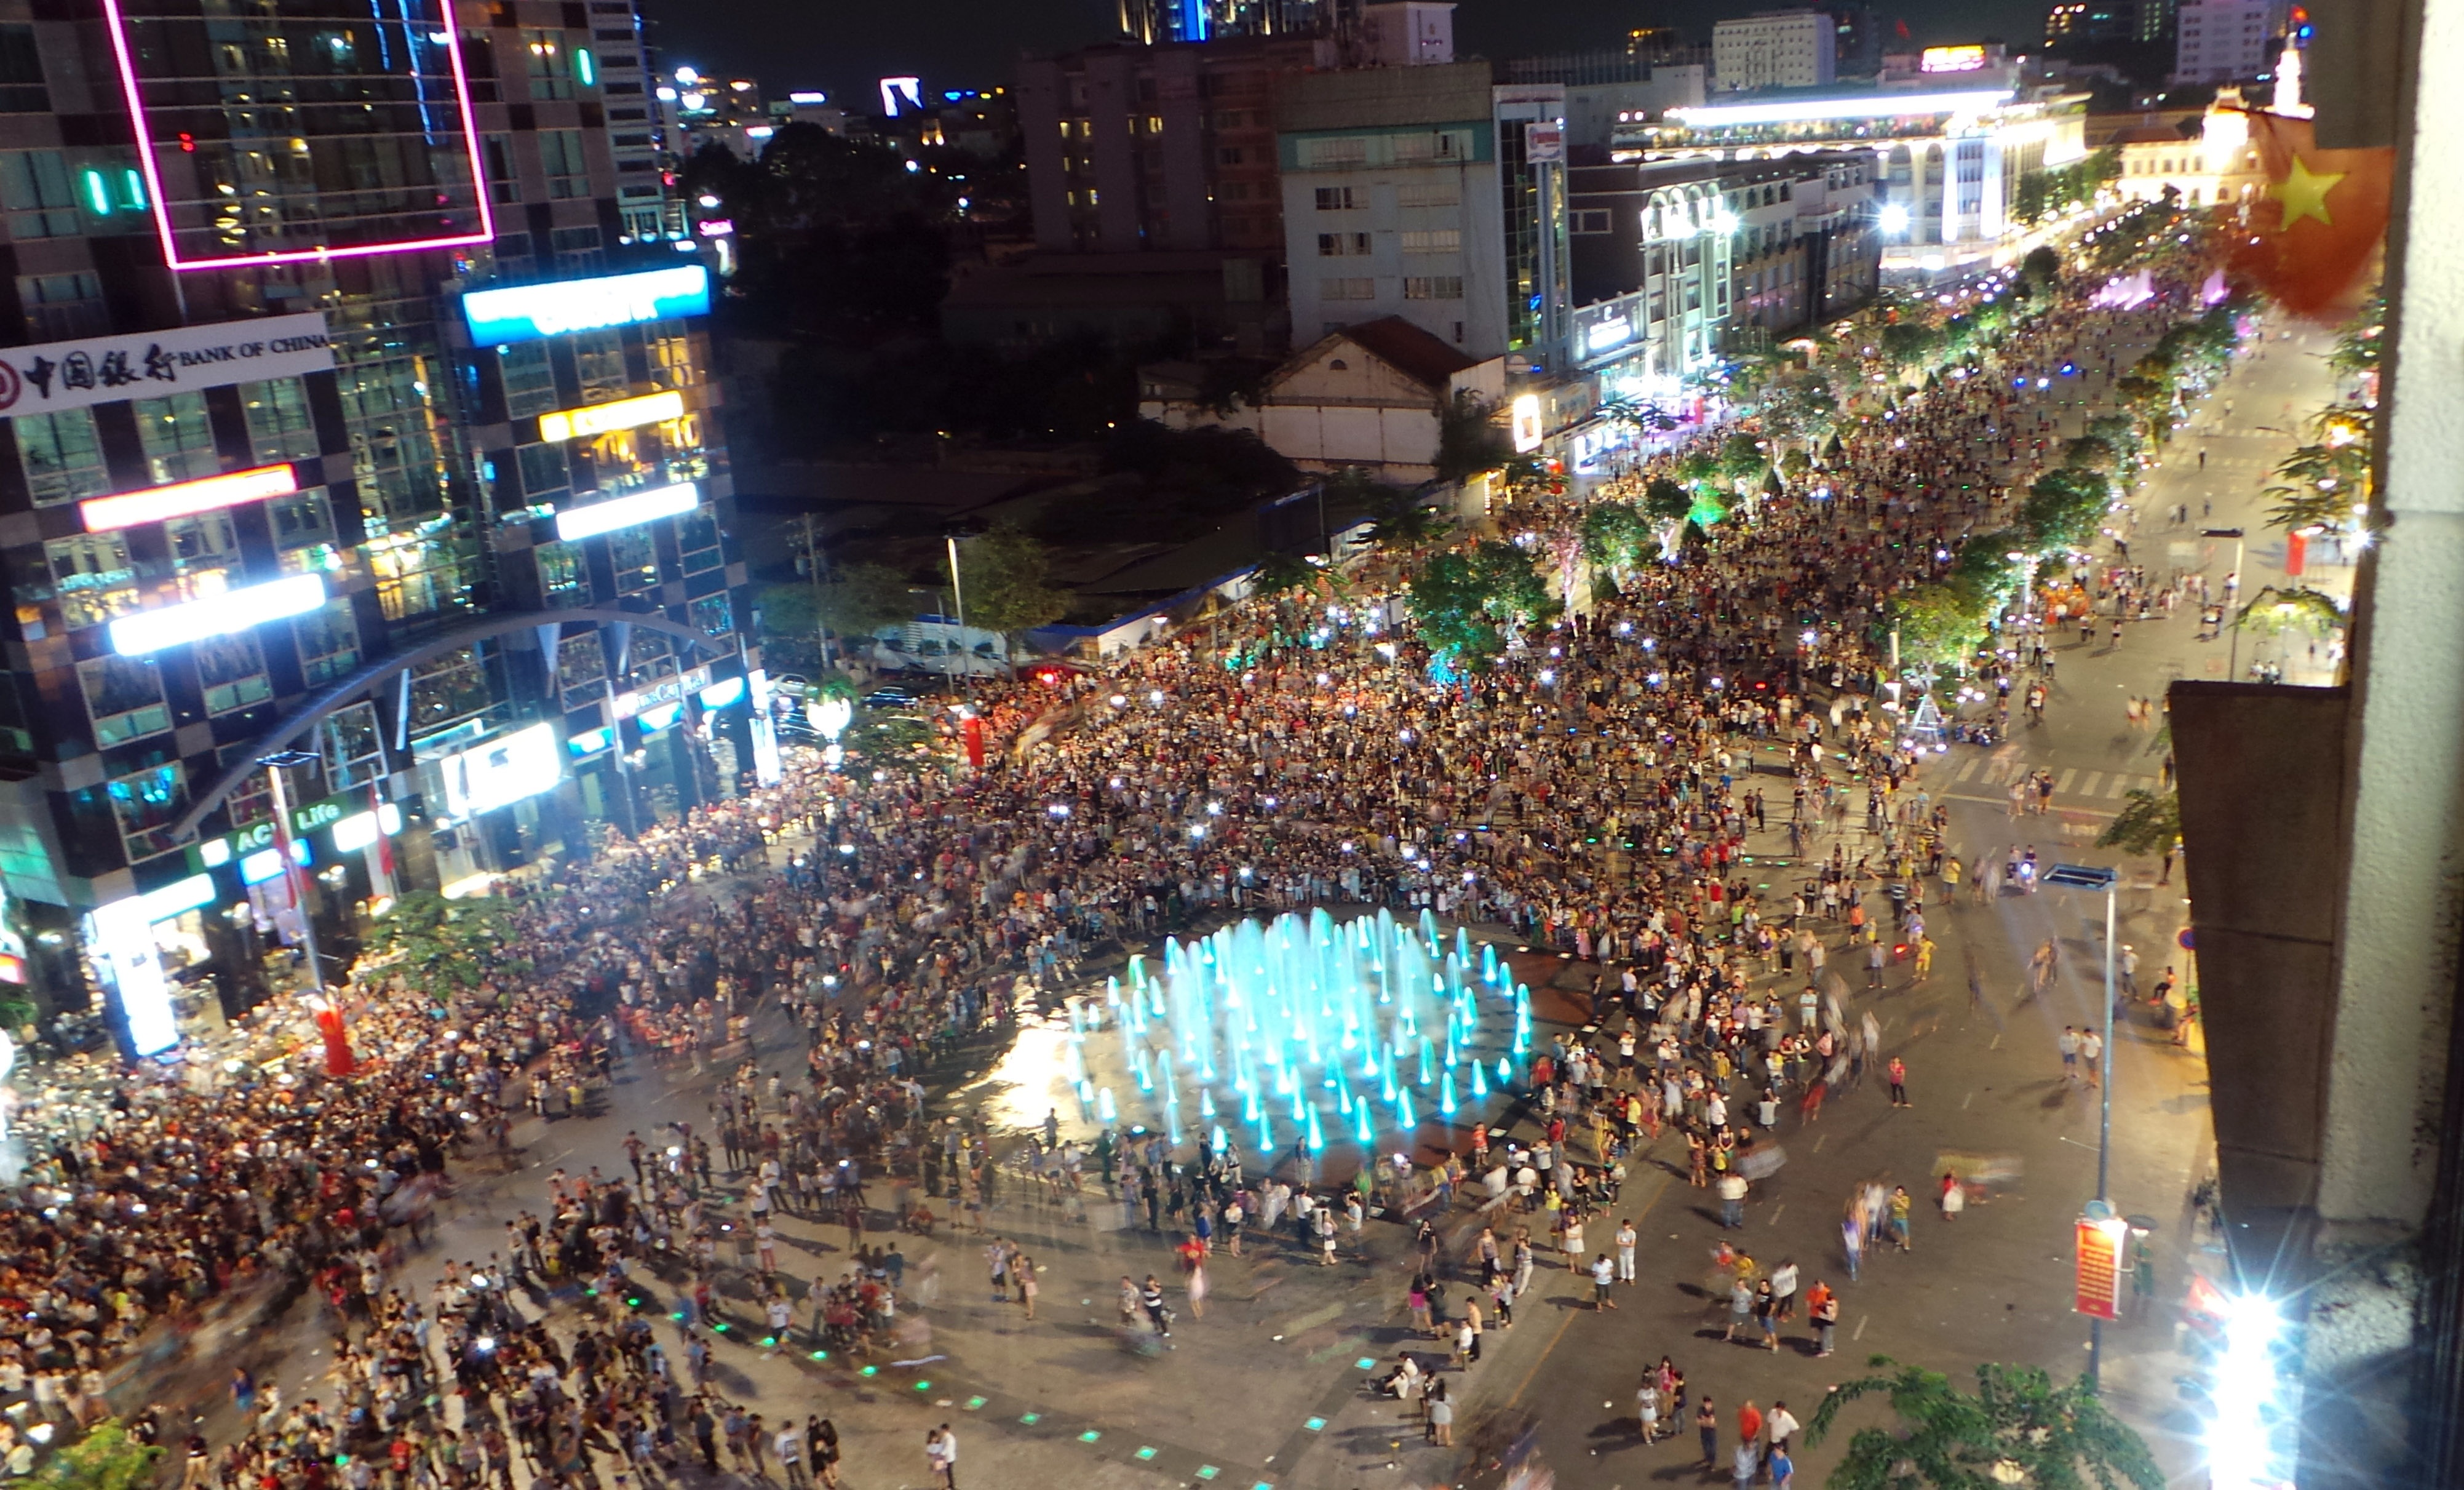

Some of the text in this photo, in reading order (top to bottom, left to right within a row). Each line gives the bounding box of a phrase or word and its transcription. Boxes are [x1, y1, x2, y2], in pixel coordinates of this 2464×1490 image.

[179, 335, 329, 366] BANK OF CHINA
[237, 803, 340, 853] AC Life
